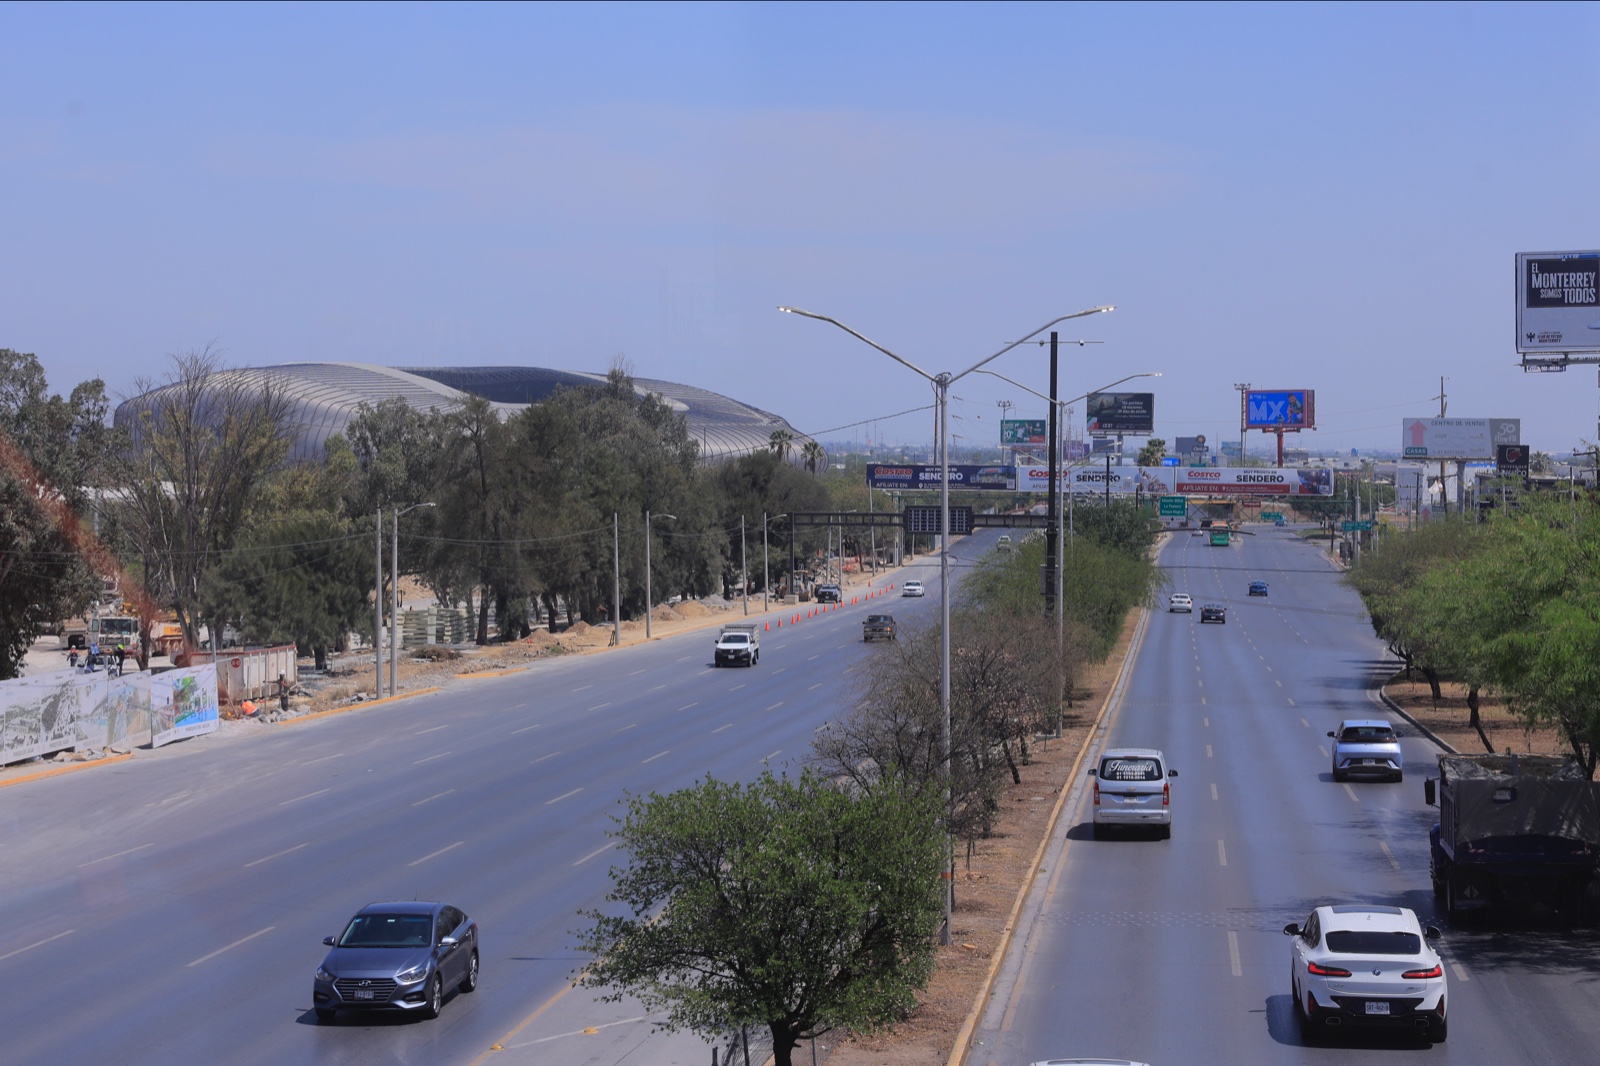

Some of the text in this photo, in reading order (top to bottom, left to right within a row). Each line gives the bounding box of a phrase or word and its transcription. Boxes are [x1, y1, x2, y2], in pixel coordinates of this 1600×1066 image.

[1532, 263, 1539, 273] EL
[1532, 272, 1596, 288] MONTERREY
[1540, 288, 1596, 304] SOMOS TODOS
[1250, 400, 1285, 420] MX
[875, 466, 913, 475] COSTCO
[1029, 469, 1068, 477] COSCO
[1109, 760, 1152, 772] Funeraria
